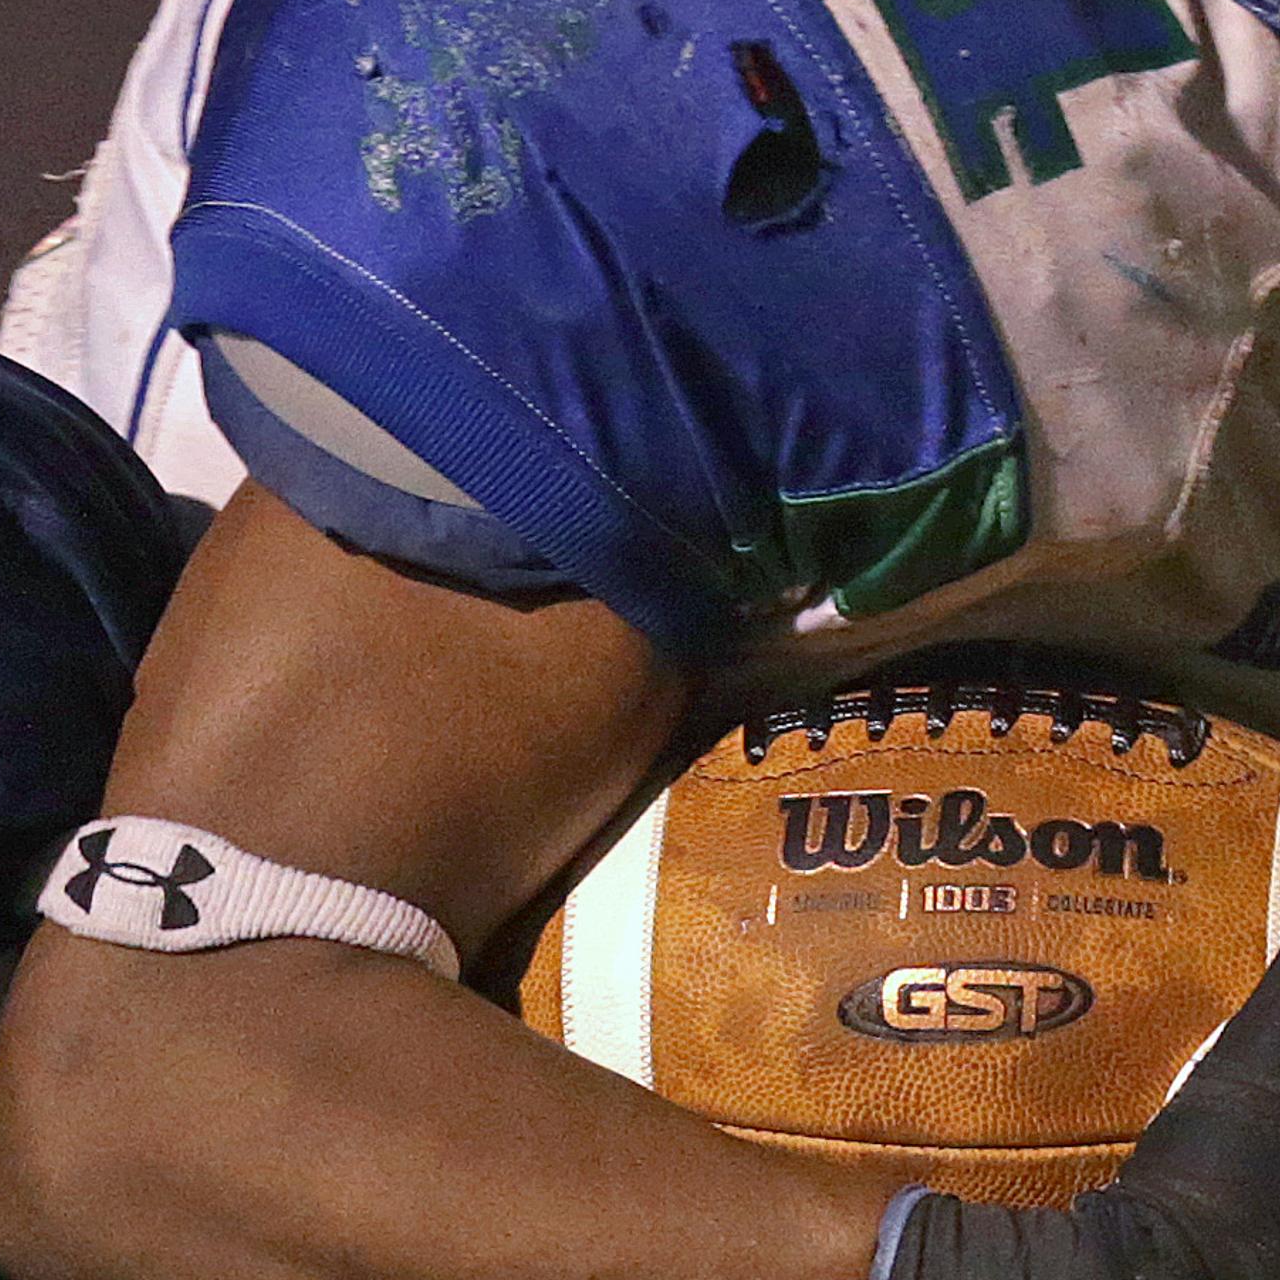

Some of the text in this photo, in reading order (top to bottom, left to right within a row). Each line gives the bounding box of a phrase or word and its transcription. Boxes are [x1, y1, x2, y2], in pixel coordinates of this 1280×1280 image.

[777, 786, 1170, 883] Wilson
[922, 883, 1017, 913] 1003
[881, 967, 1064, 1036] GST
